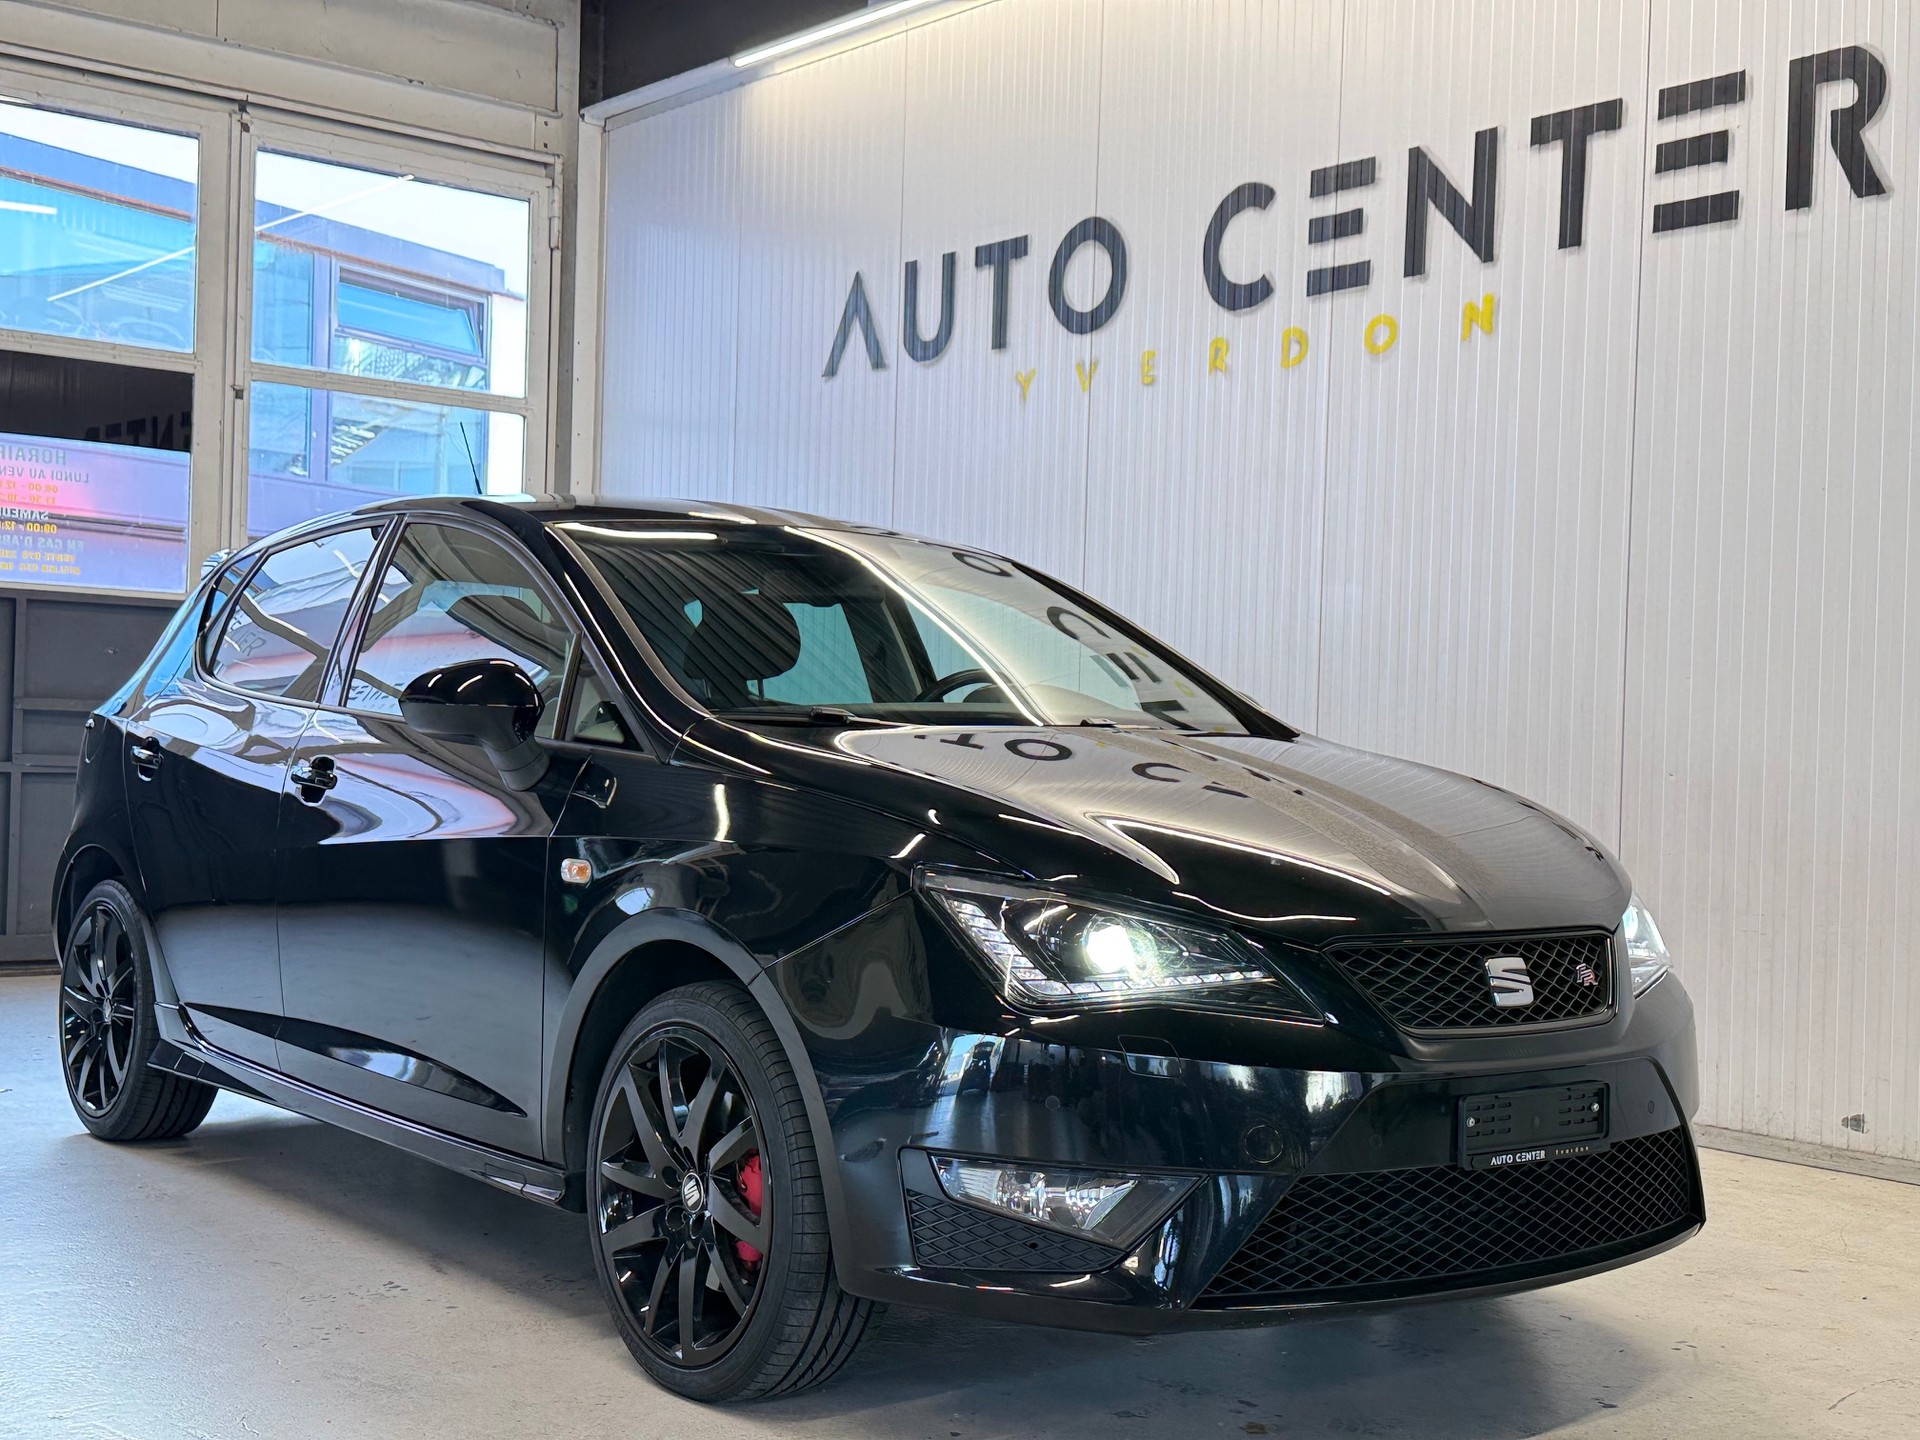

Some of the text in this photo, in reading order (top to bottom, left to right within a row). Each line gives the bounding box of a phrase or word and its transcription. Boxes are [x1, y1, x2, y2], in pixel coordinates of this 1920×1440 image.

[822, 45, 1888, 378] AUTO CENTER
[1017, 294, 1495, 399] YVERDON
[1490, 1154, 1514, 1166] AUTO
[1515, 1150, 1546, 1162] CENTER
